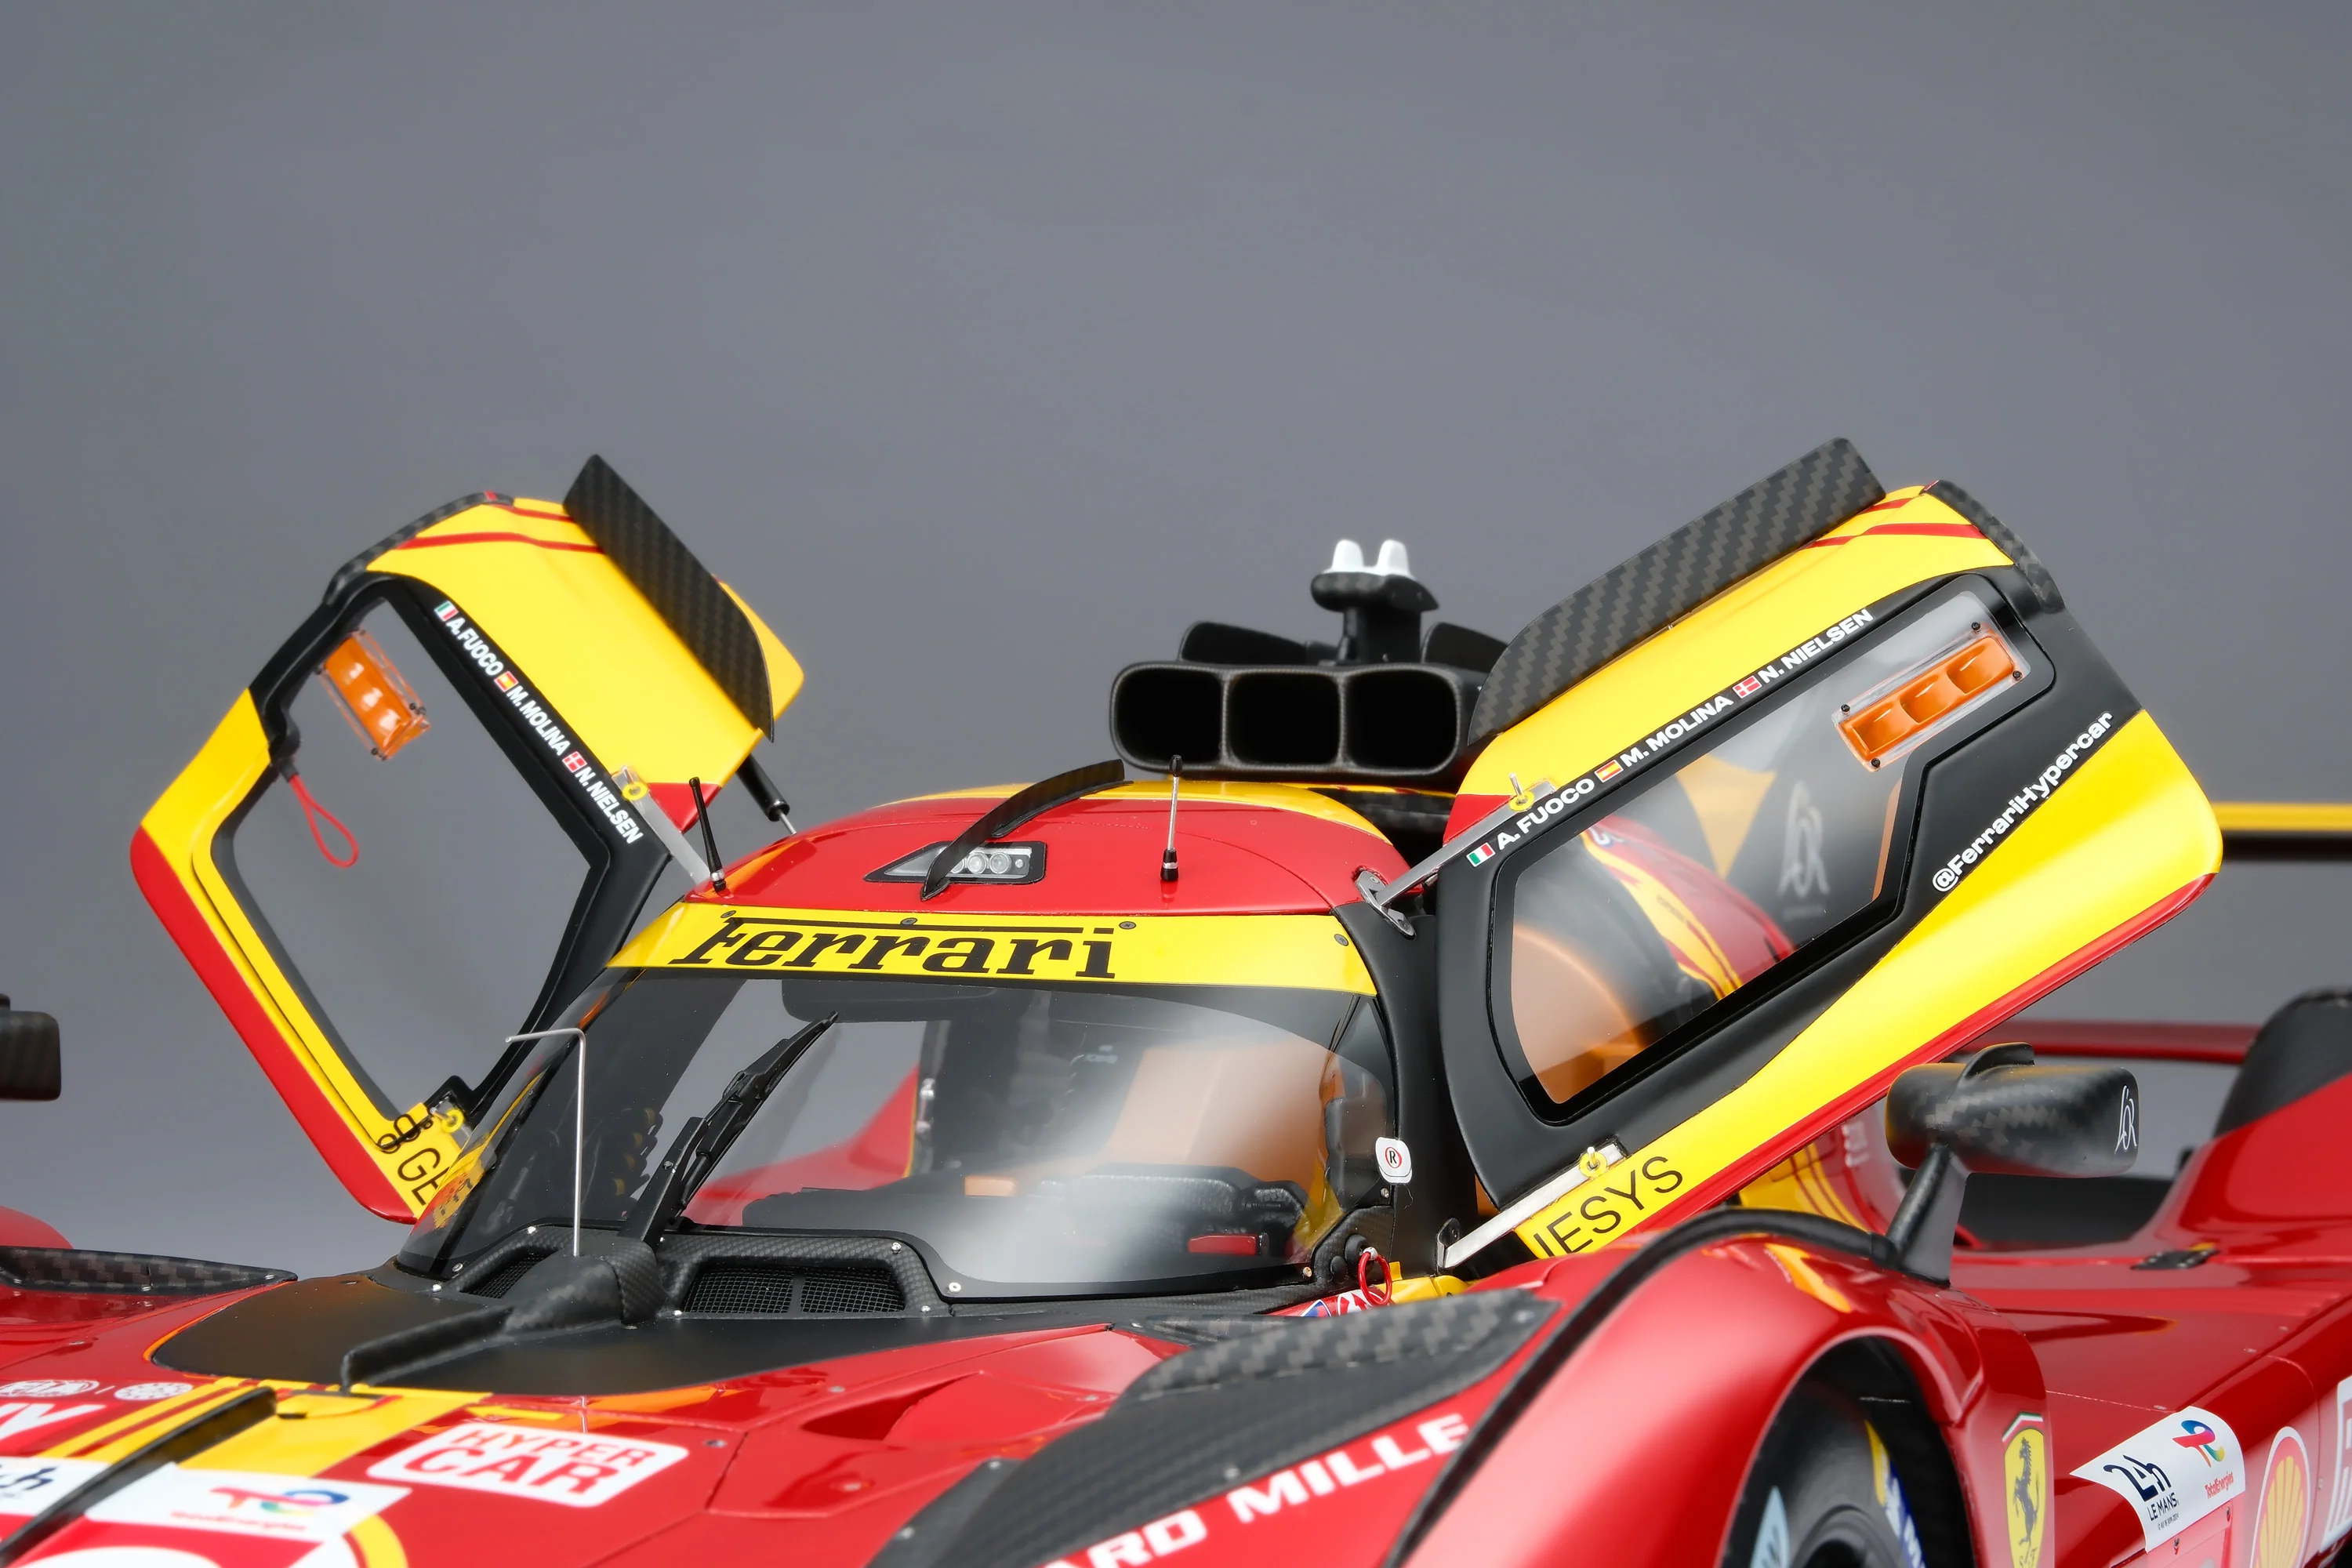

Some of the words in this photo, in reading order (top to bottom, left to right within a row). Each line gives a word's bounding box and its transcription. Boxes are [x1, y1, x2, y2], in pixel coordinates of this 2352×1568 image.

[445, 617, 466, 635] A.
[457, 627, 504, 676] FUOCO
[506, 684, 528, 707] M.
[519, 699, 571, 757] MOLINA
[575, 766, 596, 787] N.
[586, 780, 644, 844] NIELSEN
[1497, 829, 1522, 851] A.
[1515, 778, 1595, 834] FUOCO
[1620, 746, 1650, 768] M.
[1646, 695, 1734, 752] MOLINA
[1757, 665, 1785, 684] N.
[1780, 608, 1875, 670] NIELSEN
[1932, 711, 2113, 892] @FerrariHypercar
[668, 916, 1116, 979] Ferrari
[402, 1446, 620, 1495] CAR
[449, 1428, 657, 1468] HYPER
[1043, 1508, 1209, 1568] RD
[1226, 1413, 1470, 1523] MILLE
[2147, 1504, 2158, 1521] LE
[2156, 1492, 2178, 1517] MANS
